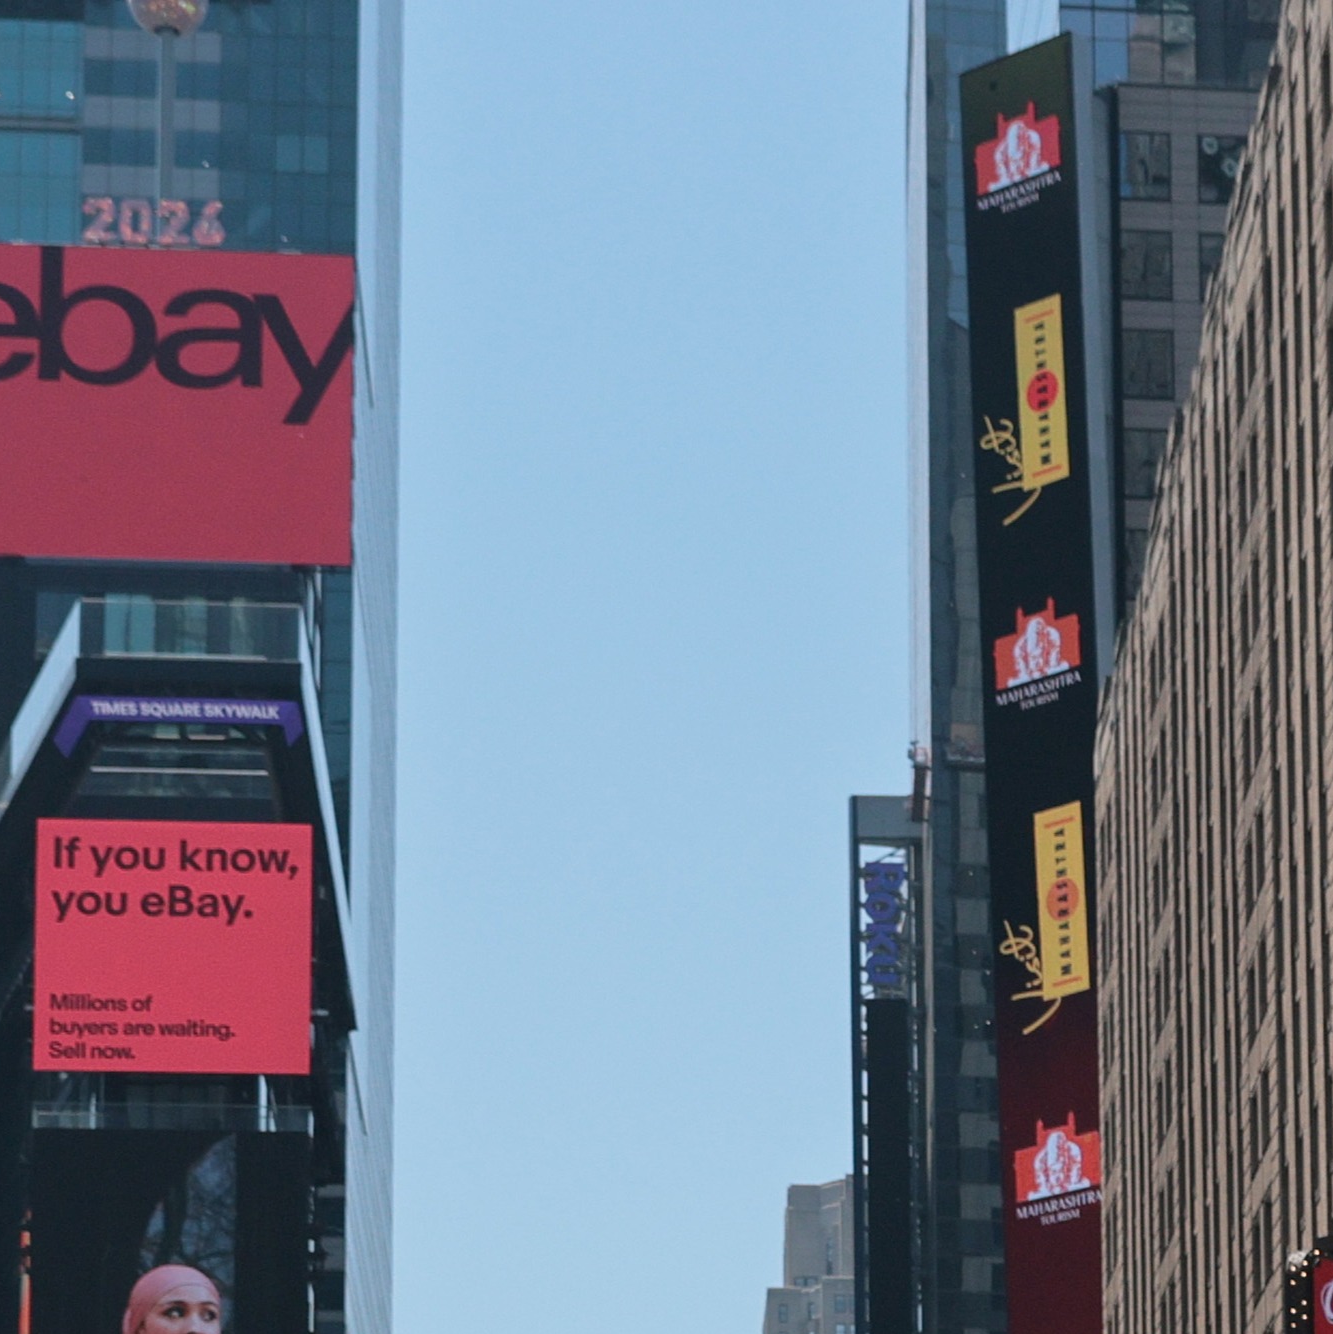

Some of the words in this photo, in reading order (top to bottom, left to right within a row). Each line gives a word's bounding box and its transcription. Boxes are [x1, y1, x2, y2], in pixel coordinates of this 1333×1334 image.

[976, 168, 1063, 211] MAHARASHTRA
[82, 197, 226, 246] 2026
[995, 669, 1082, 707] MAHARASHTRA
[91, 700, 137, 717] TIMES
[139, 702, 201, 719] SQUARE
[203, 703, 280, 721] SKYWALK
[53, 837, 81, 869] If
[90, 844, 166, 878] you
[179, 841, 299, 879] know,
[51, 889, 129, 922] you
[140, 887, 254, 926] eBay.
[1053, 826, 1074, 978] MAHARASHTRA
[48, 993, 127, 1013] Millions
[131, 994, 152, 1013] of
[48, 1018, 119, 1038] buyers
[122, 1022, 155, 1037] are
[158, 1019, 236, 1041] waiting.
[48, 1041, 86, 1059] Sell
[90, 1044, 135, 1060] now.
[1015, 1188, 1104, 1220] MAHARASHTRA
[1040, 1207, 1081, 1226] TOURISM
